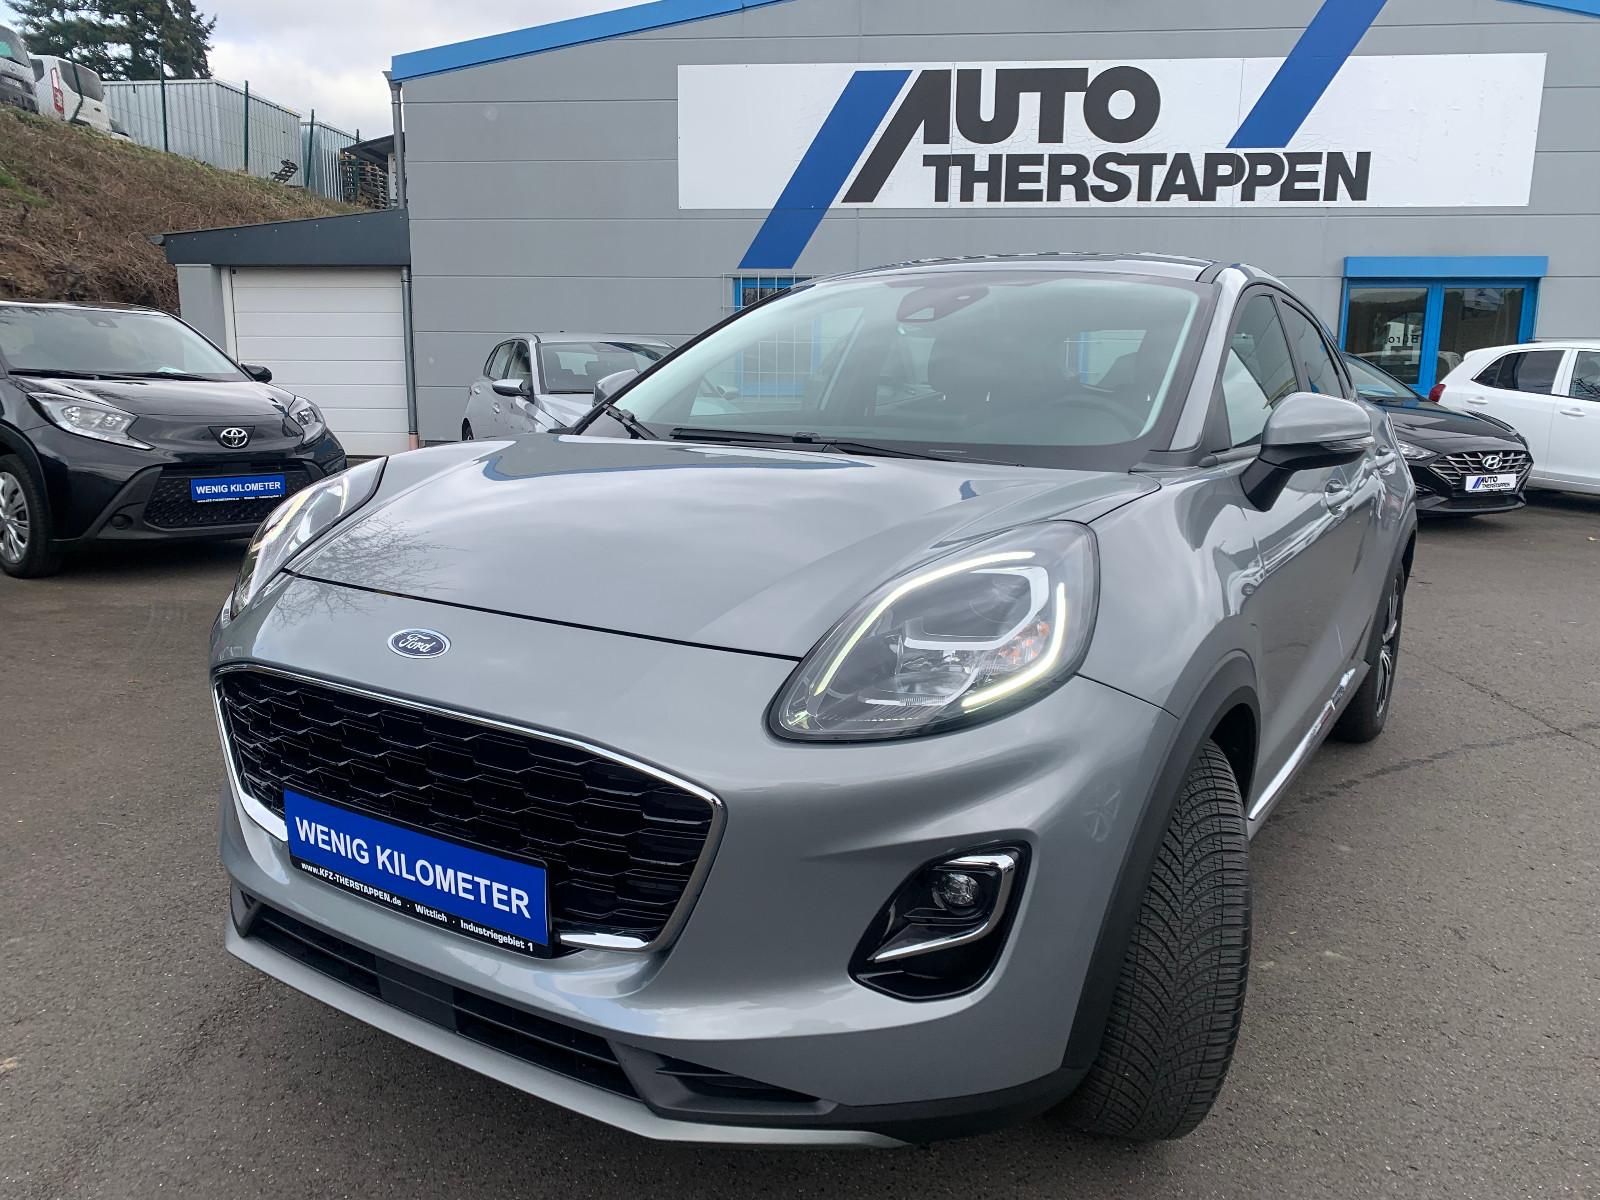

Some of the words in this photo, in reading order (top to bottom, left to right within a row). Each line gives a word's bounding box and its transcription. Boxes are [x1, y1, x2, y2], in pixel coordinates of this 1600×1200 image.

[842, 66, 1160, 203] AUTO
[923, 151, 1371, 202] THERSTAPPEN
[196, 484, 228, 495] WENIG
[230, 481, 281, 492] KILOMETER
[1477, 476, 1498, 487] AUTO
[398, 633, 436, 653] Ford
[295, 816, 370, 864] WENIG
[376, 846, 531, 919] KILOMETER
[301, 862, 402, 906] www.KFZ-THERSTAPPEN.de
[415, 903, 448, 923] Wittlich
[460, 919, 525, 949] Industriegebiet
[527, 942, 534, 952] 1
